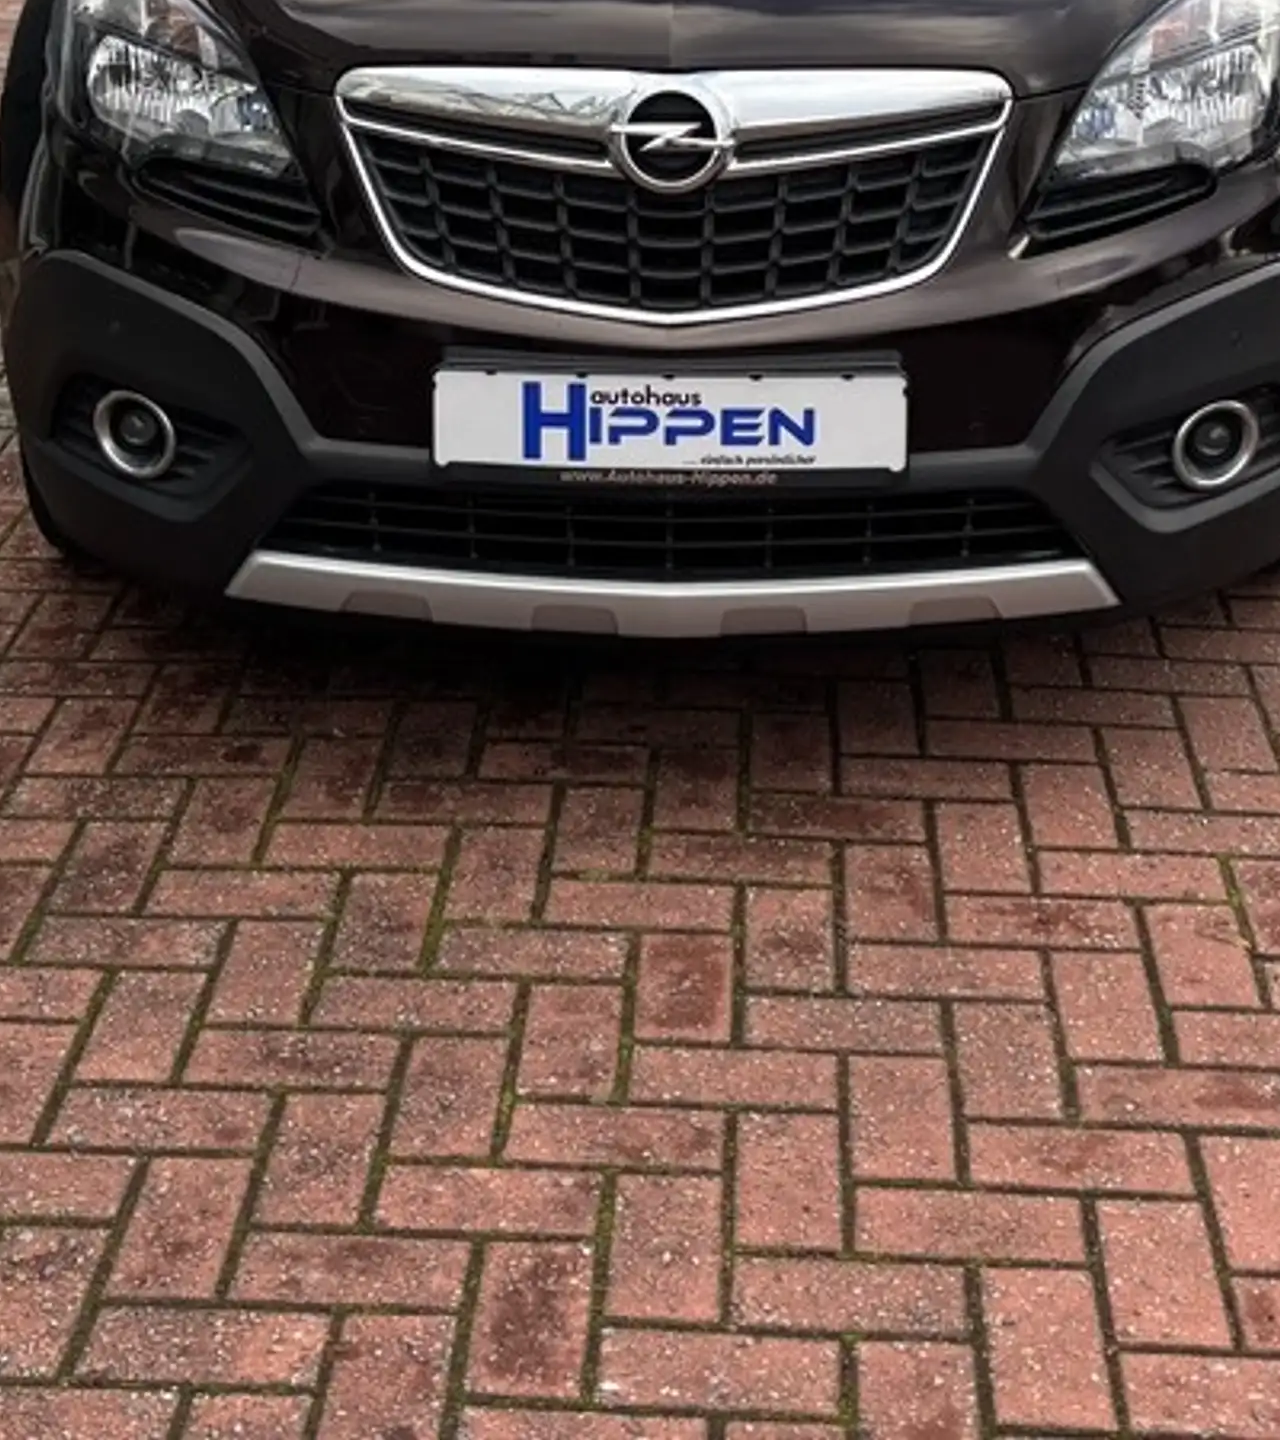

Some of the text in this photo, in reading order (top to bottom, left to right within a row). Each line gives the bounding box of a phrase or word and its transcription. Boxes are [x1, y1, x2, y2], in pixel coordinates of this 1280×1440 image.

[589, 384, 703, 406] autohaus
[522, 381, 816, 461] HIPPEN
[560, 469, 778, 486] www.Autohaus-Hippen.de
